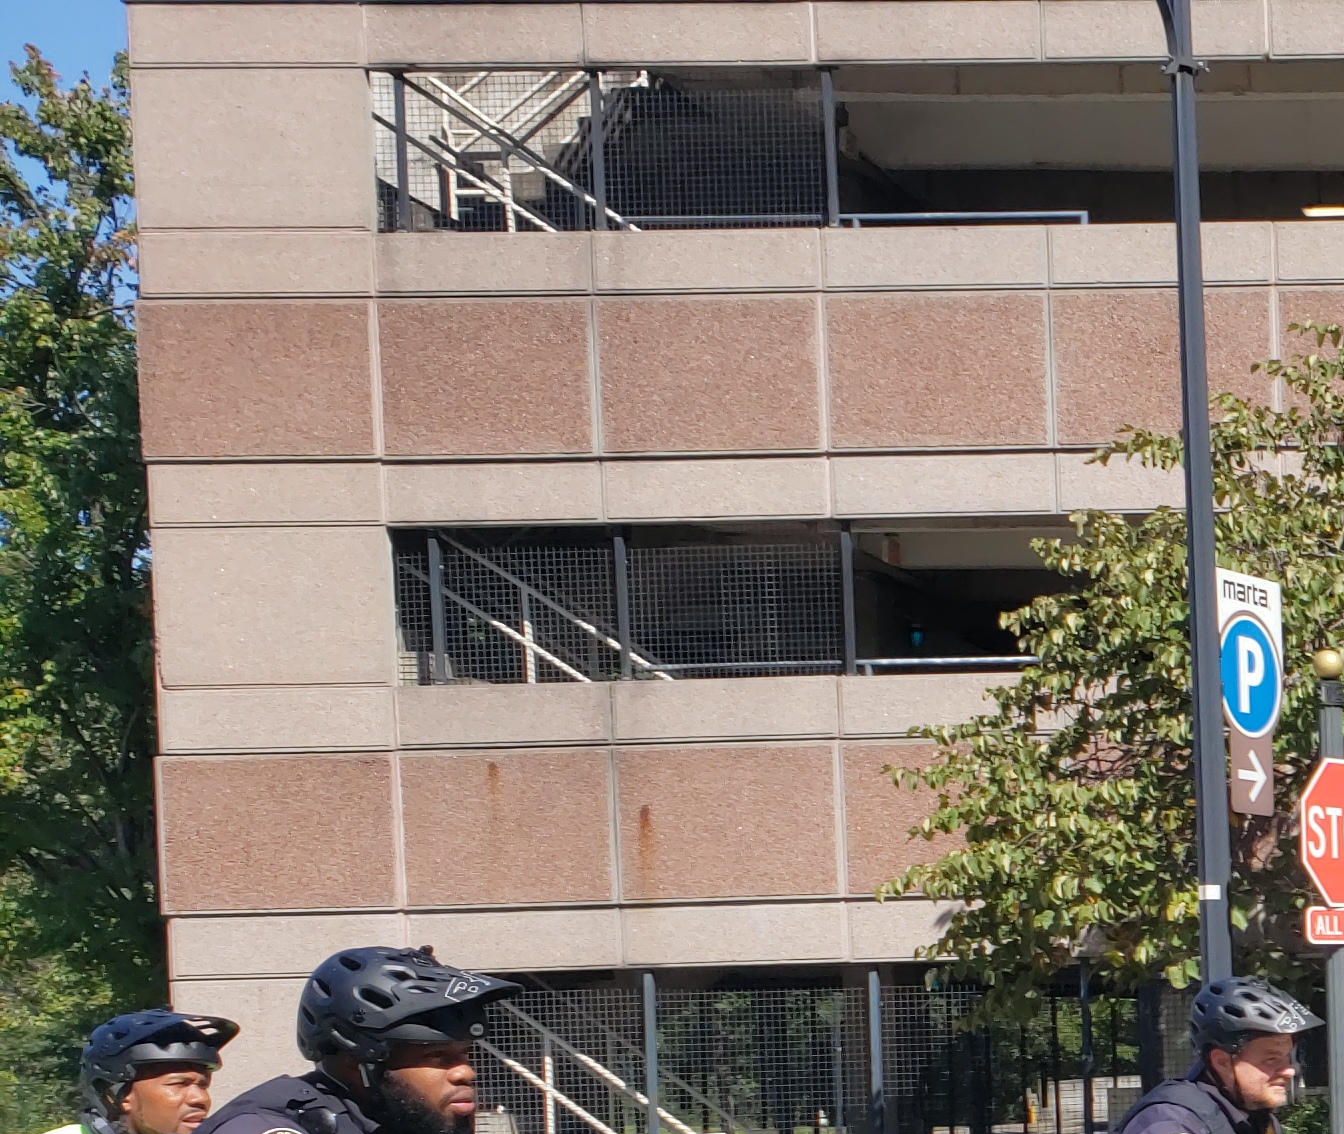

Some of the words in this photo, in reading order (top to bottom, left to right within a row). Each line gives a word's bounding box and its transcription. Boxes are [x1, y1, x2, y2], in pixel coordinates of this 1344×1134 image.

[1223, 579, 1268, 608] marta
[1236, 634, 1265, 714] P
[1314, 915, 1344, 936] ALL
